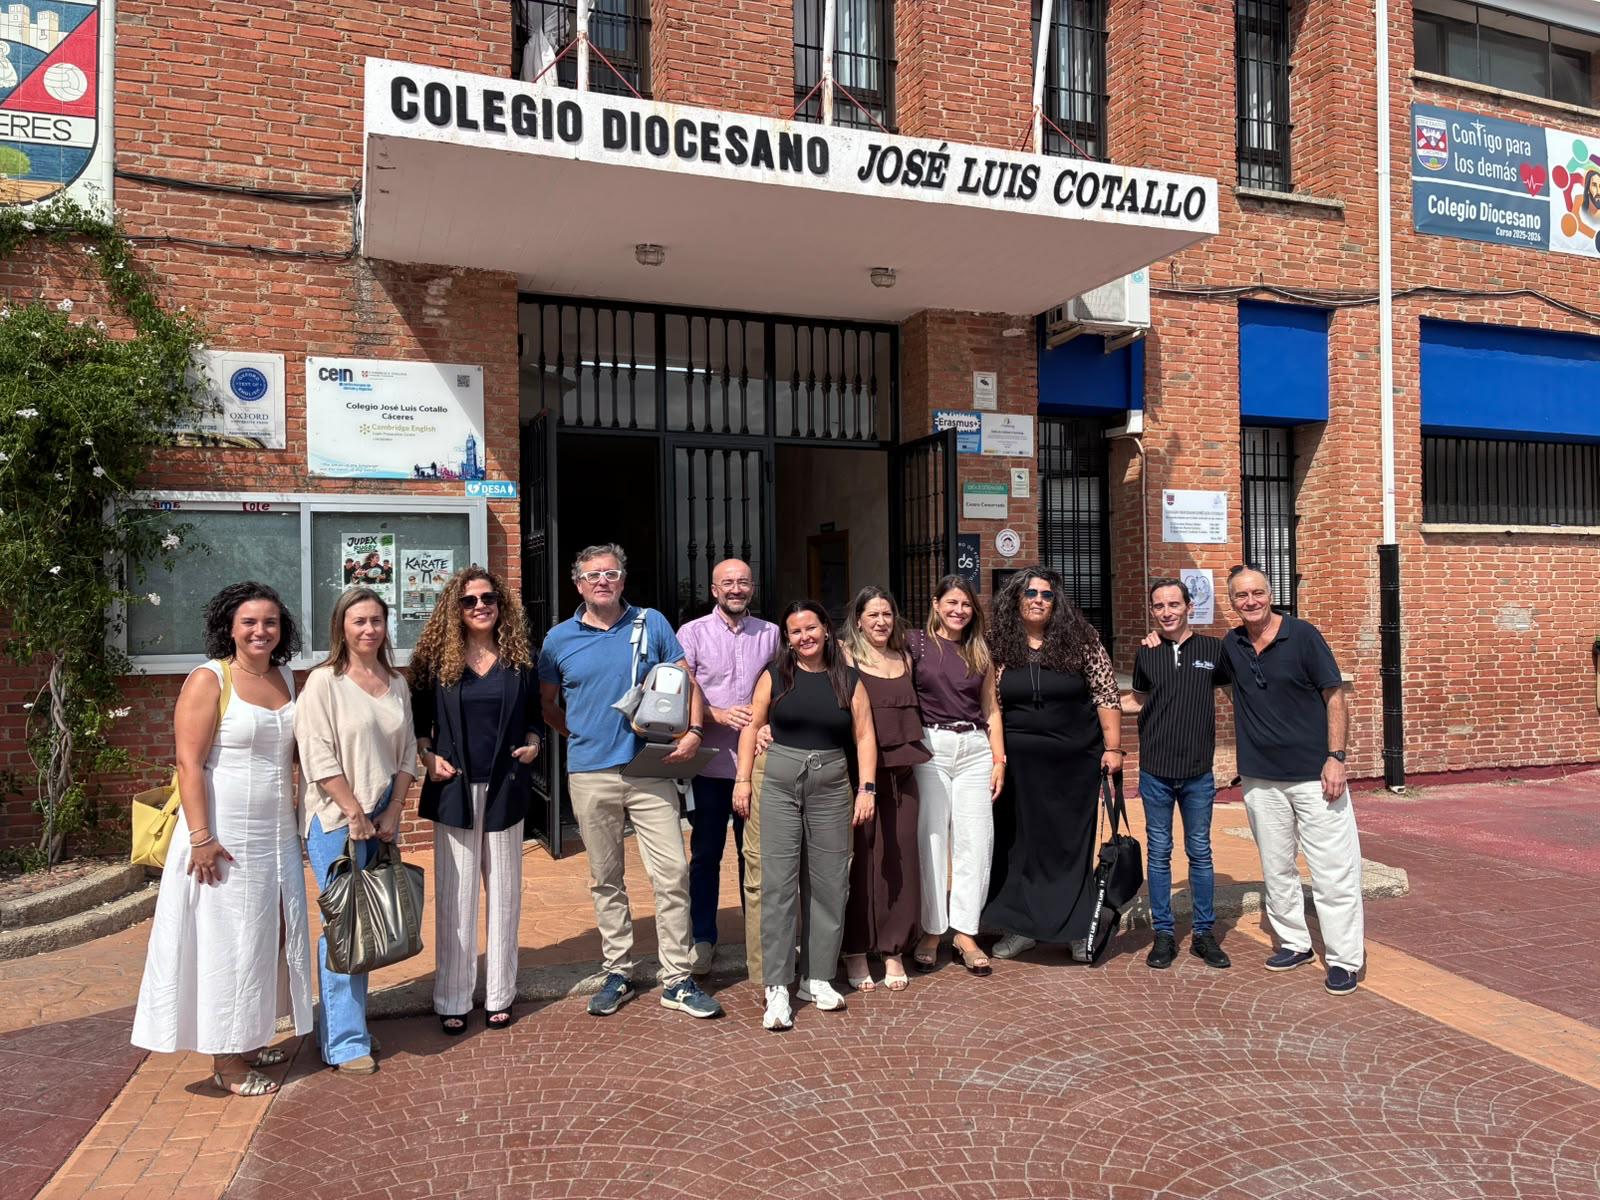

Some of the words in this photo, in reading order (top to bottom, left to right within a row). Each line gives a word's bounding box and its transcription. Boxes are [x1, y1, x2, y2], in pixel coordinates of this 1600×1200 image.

[391, 76, 582, 142] COLEGIO
[602, 108, 829, 175] DIOCESANO
[857, 142, 950, 189] JOSÉ
[957, 157, 1041, 200] LUIS
[1053, 169, 1206, 221] COTALLO
[1505, 138, 1531, 157] para
[1454, 152, 1474, 174] los
[1478, 156, 1517, 182] demás
[1428, 194, 1477, 222] Colegio
[1480, 202, 1541, 230] Diocesano
[1496, 226, 1512, 236] Curso
[1513, 229, 1541, 241] 2025-2026
[318, 367, 354, 382] cein
[346, 402, 379, 412] Colegio
[380, 402, 399, 411] José
[400, 404, 417, 412] Luis
[418, 405, 448, 413] Cotallo
[230, 412, 269, 420] OXFORD
[382, 412, 414, 421] Cáceres
[372, 424, 410, 433] Cambridge
[411, 424, 437, 433] English
[938, 417, 978, 428] Erasmus+
[481, 484, 507, 494] DESA
[347, 536, 378, 547] JUDEX
[405, 557, 449, 570] KARATE
